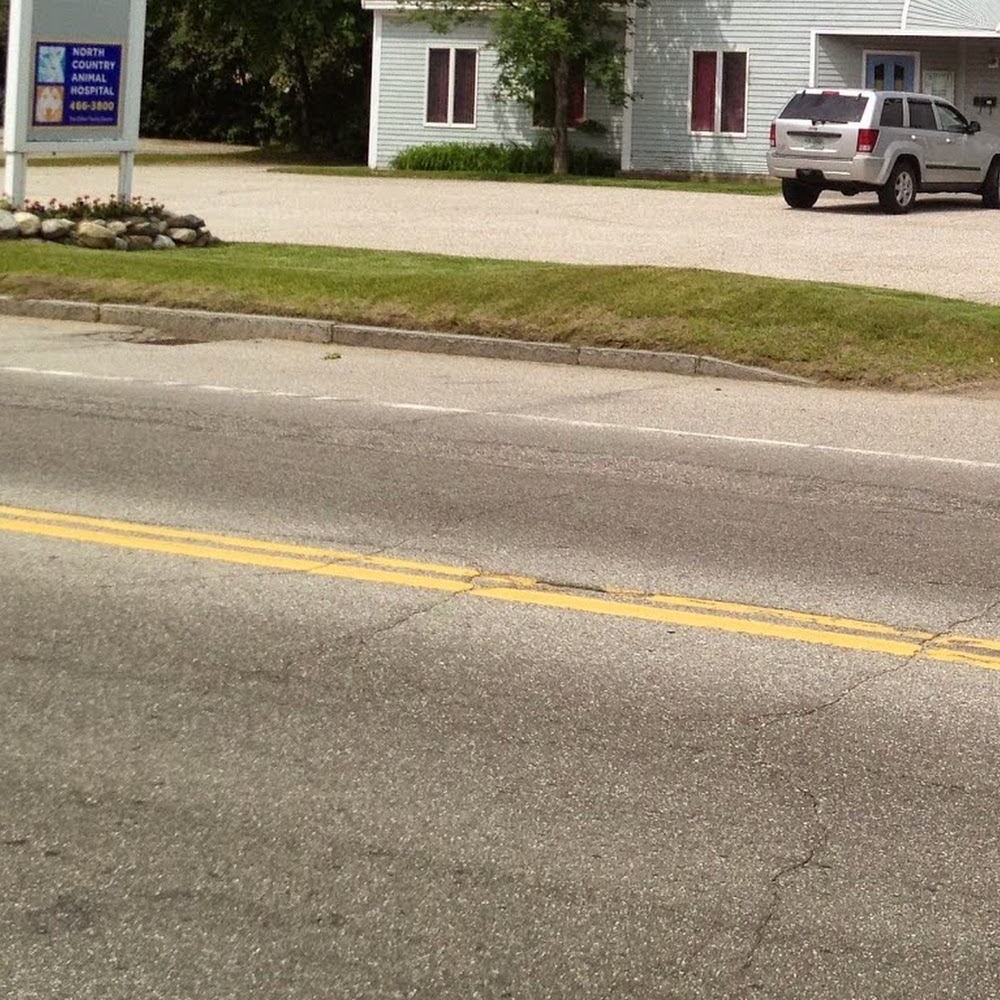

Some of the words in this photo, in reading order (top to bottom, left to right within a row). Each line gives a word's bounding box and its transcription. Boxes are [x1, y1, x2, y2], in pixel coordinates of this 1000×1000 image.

[72, 47, 105, 57] NORTH
[71, 60, 116, 70] COUNTRY
[71, 73, 107, 83] ANIMAL
[70, 86, 115, 96] HOSPITAL
